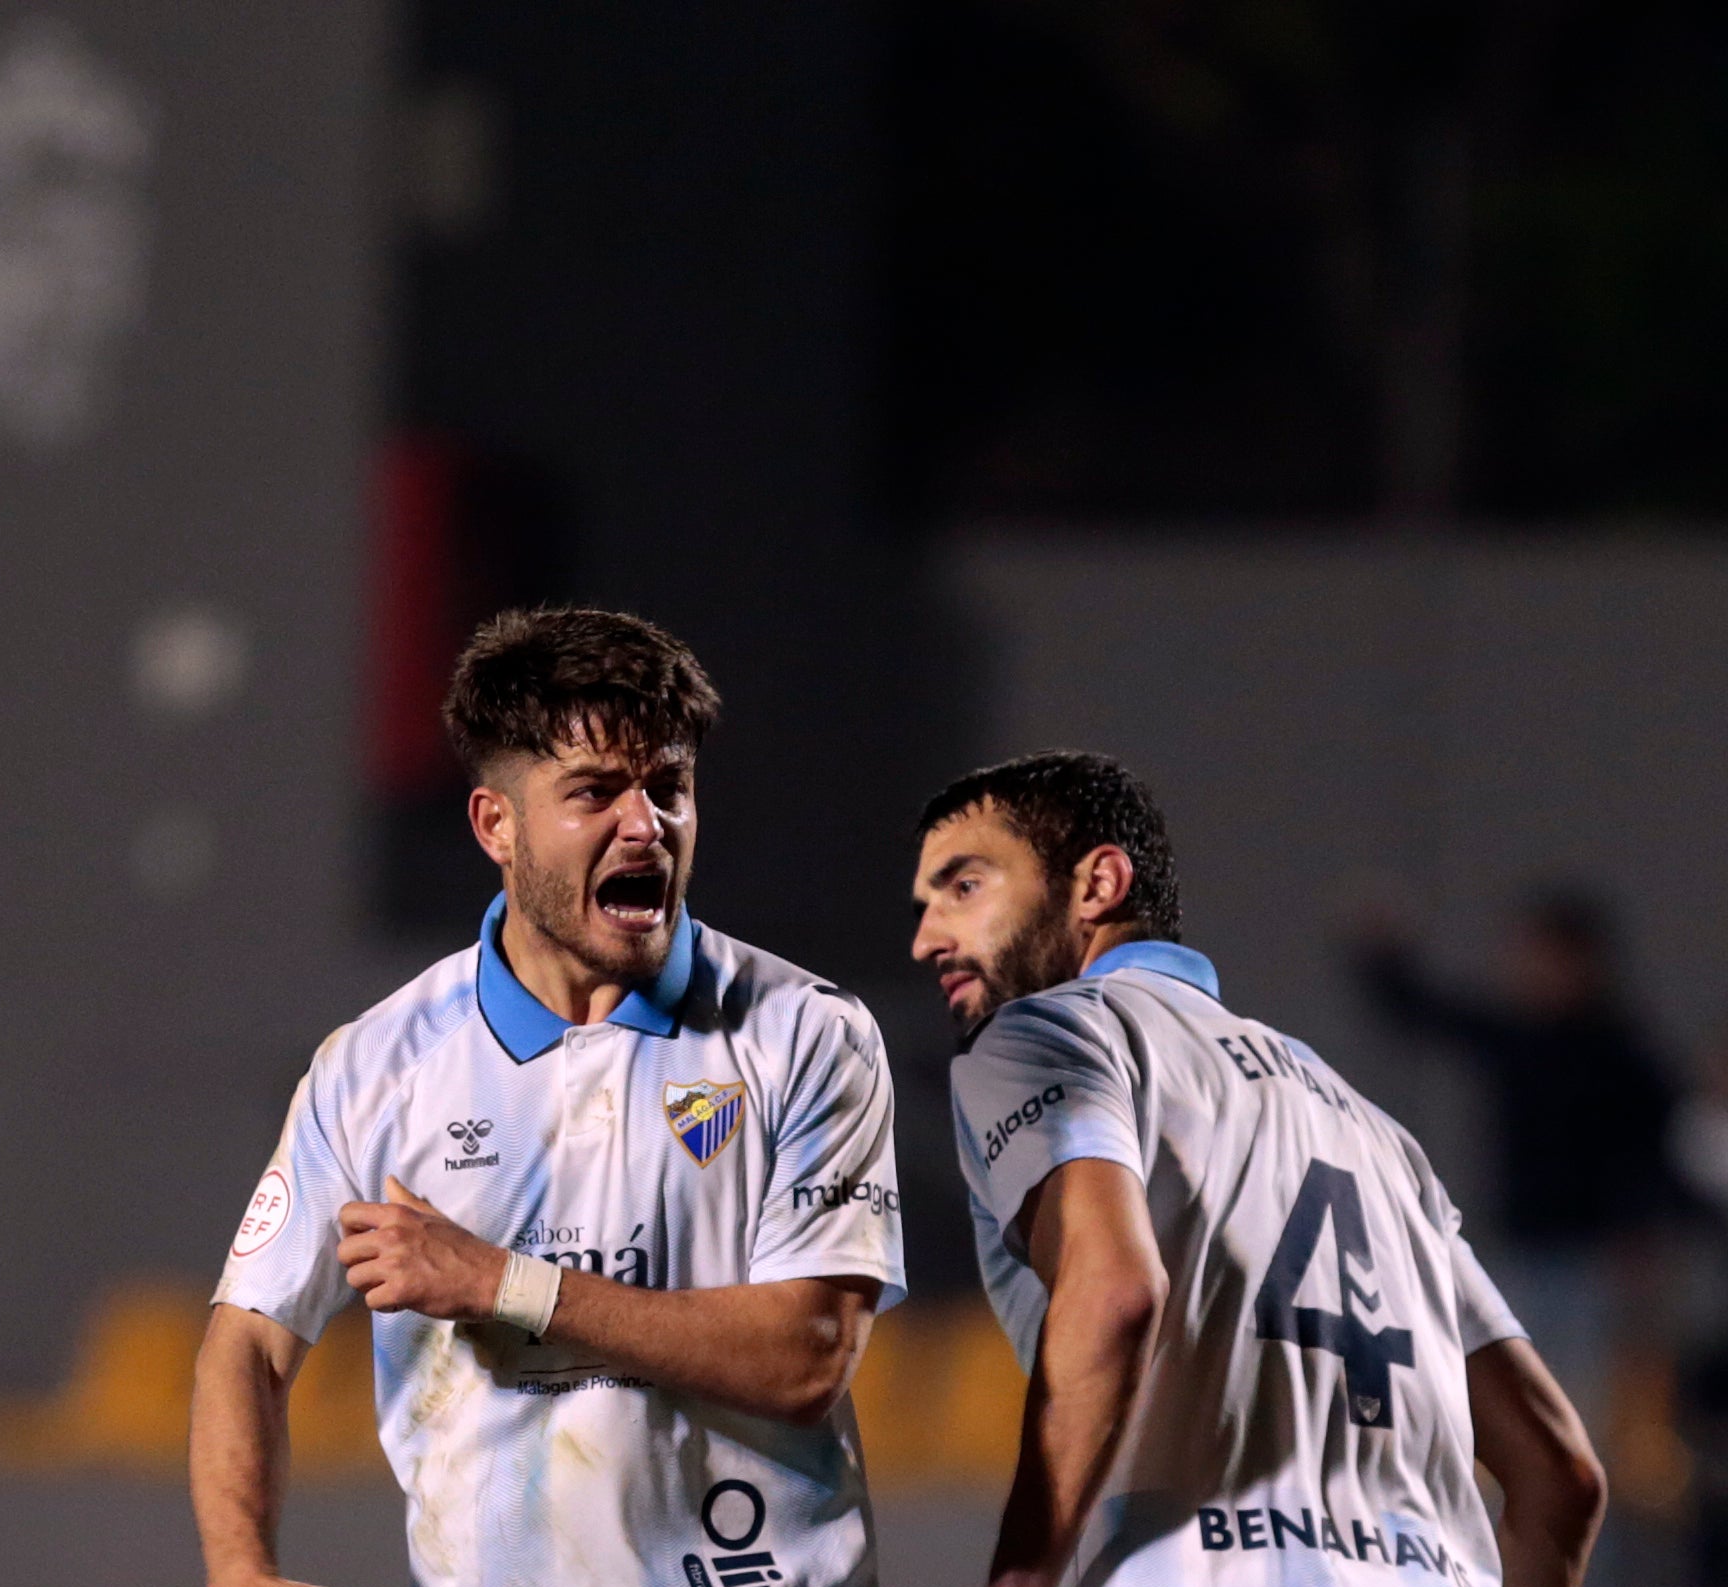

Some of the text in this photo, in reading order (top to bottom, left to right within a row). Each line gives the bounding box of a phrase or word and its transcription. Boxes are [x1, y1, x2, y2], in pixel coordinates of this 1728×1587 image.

[445, 1152, 500, 1171] hummel
[515, 1219, 585, 1246] sabor
[1255, 1157, 1414, 1430] 4
[517, 1373, 655, 1397] Málaga es Provin
